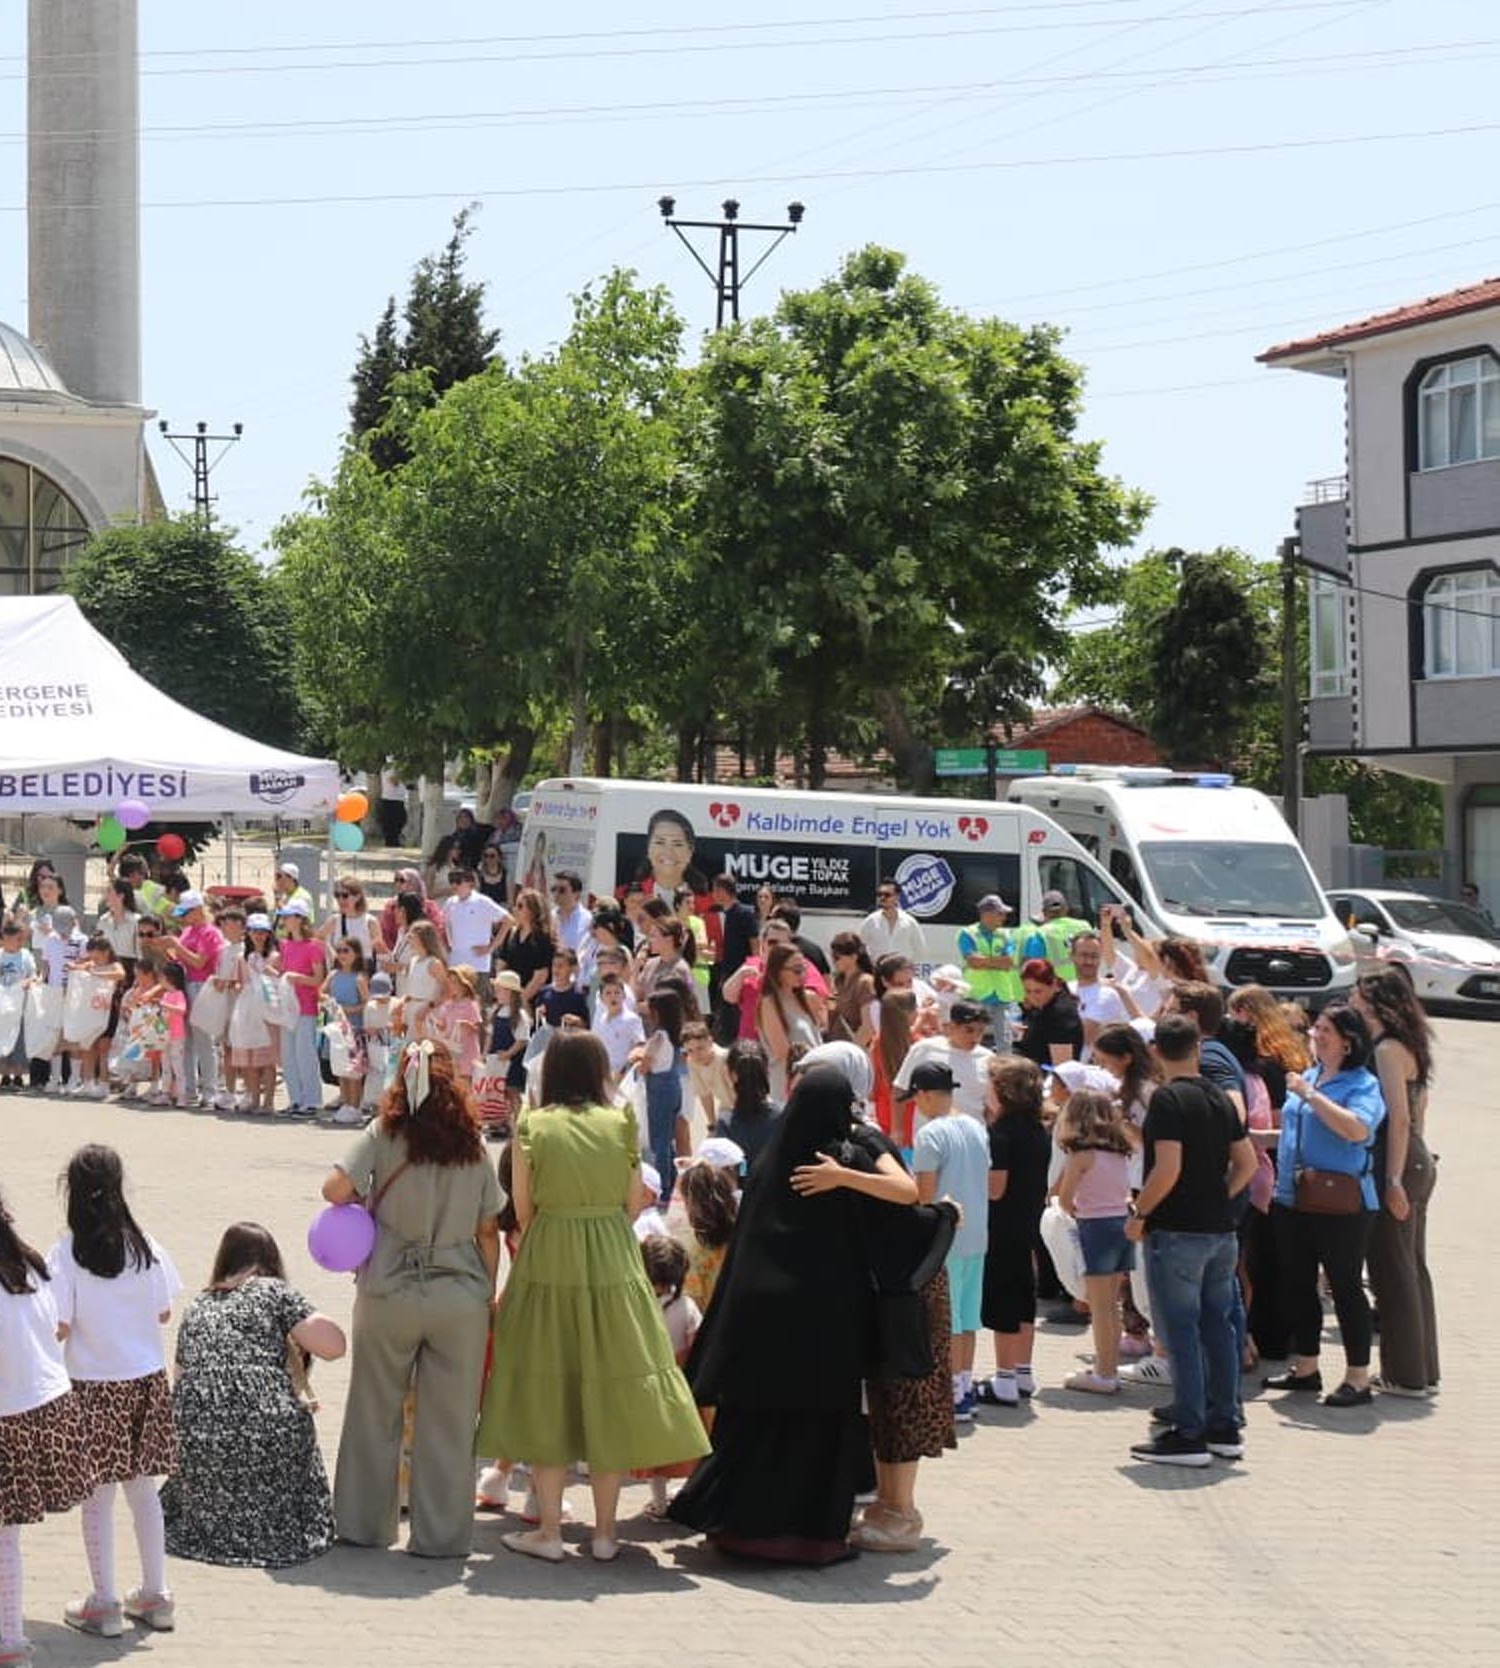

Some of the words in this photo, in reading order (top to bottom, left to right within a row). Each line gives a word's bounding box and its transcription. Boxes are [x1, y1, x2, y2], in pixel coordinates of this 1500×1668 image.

[747, 812, 844, 834] Kalbimde
[852, 816, 907, 841] Engel
[915, 820, 951, 838] Yok
[809, 869, 849, 882] TOPAK
